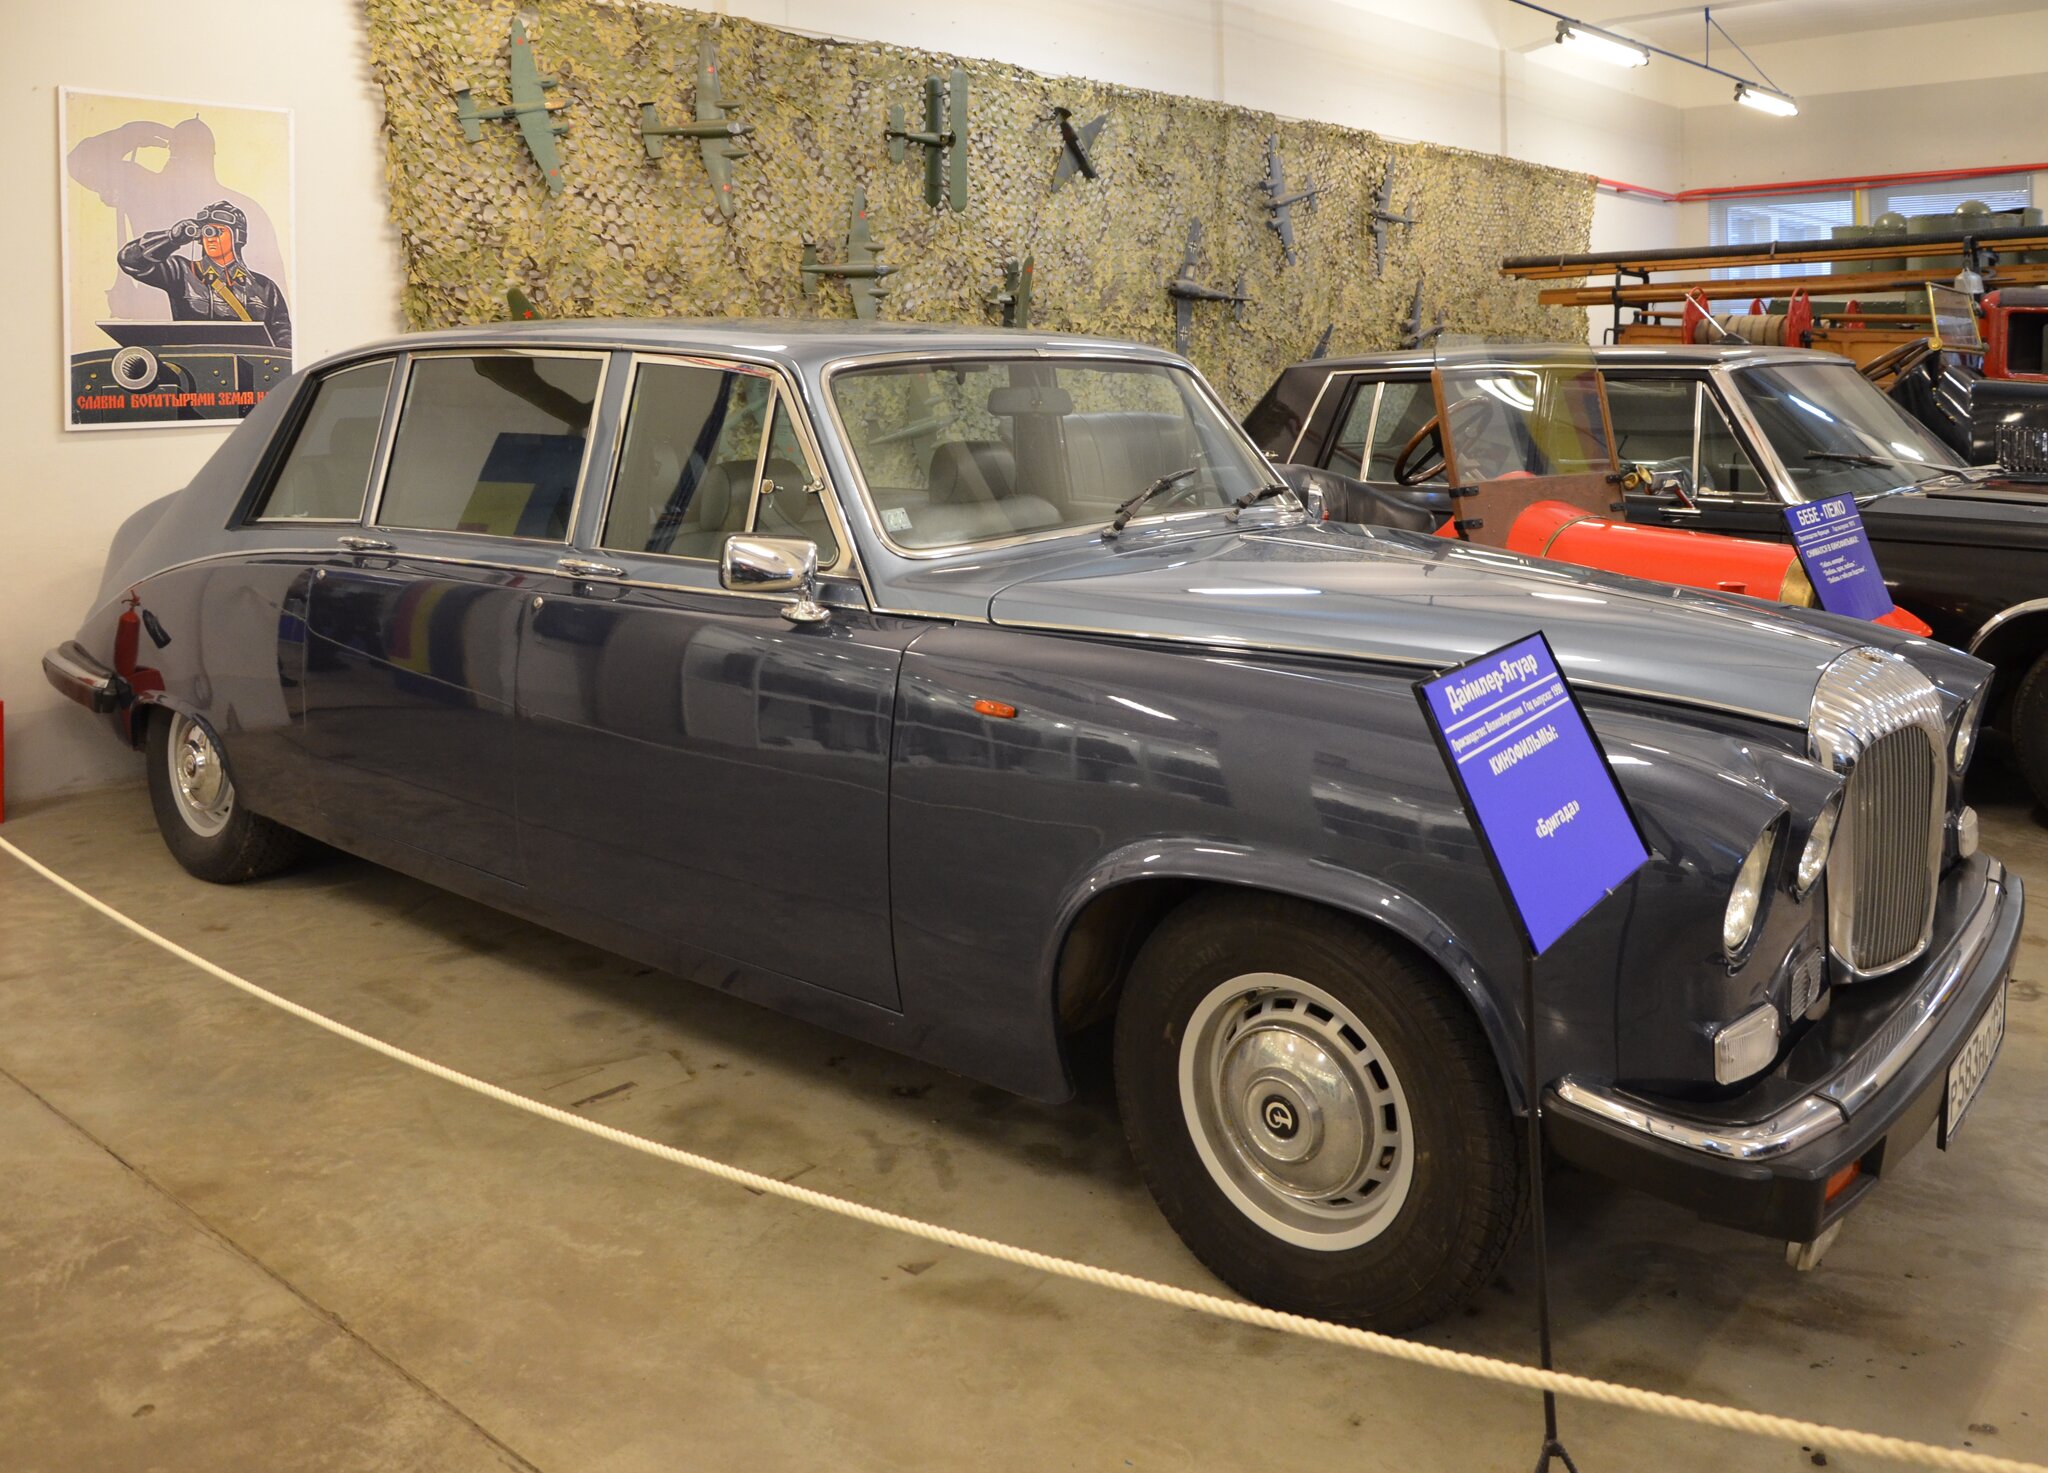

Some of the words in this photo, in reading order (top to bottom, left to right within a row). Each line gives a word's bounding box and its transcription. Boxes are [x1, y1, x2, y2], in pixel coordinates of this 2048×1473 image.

[77, 394, 125, 409] СЛАВНА
[131, 392, 215, 408] БОГАТЫРЯМИ
[1796, 507, 1821, 526] БЕБЕ
[1822, 500, 1846, 519] ПЕЖО
[1445, 654, 1538, 715] Даймлер-Ягуар
[1489, 724, 1559, 776] КИНОФИЛЬМЫ:
[1536, 800, 1580, 838] «Бригада»
